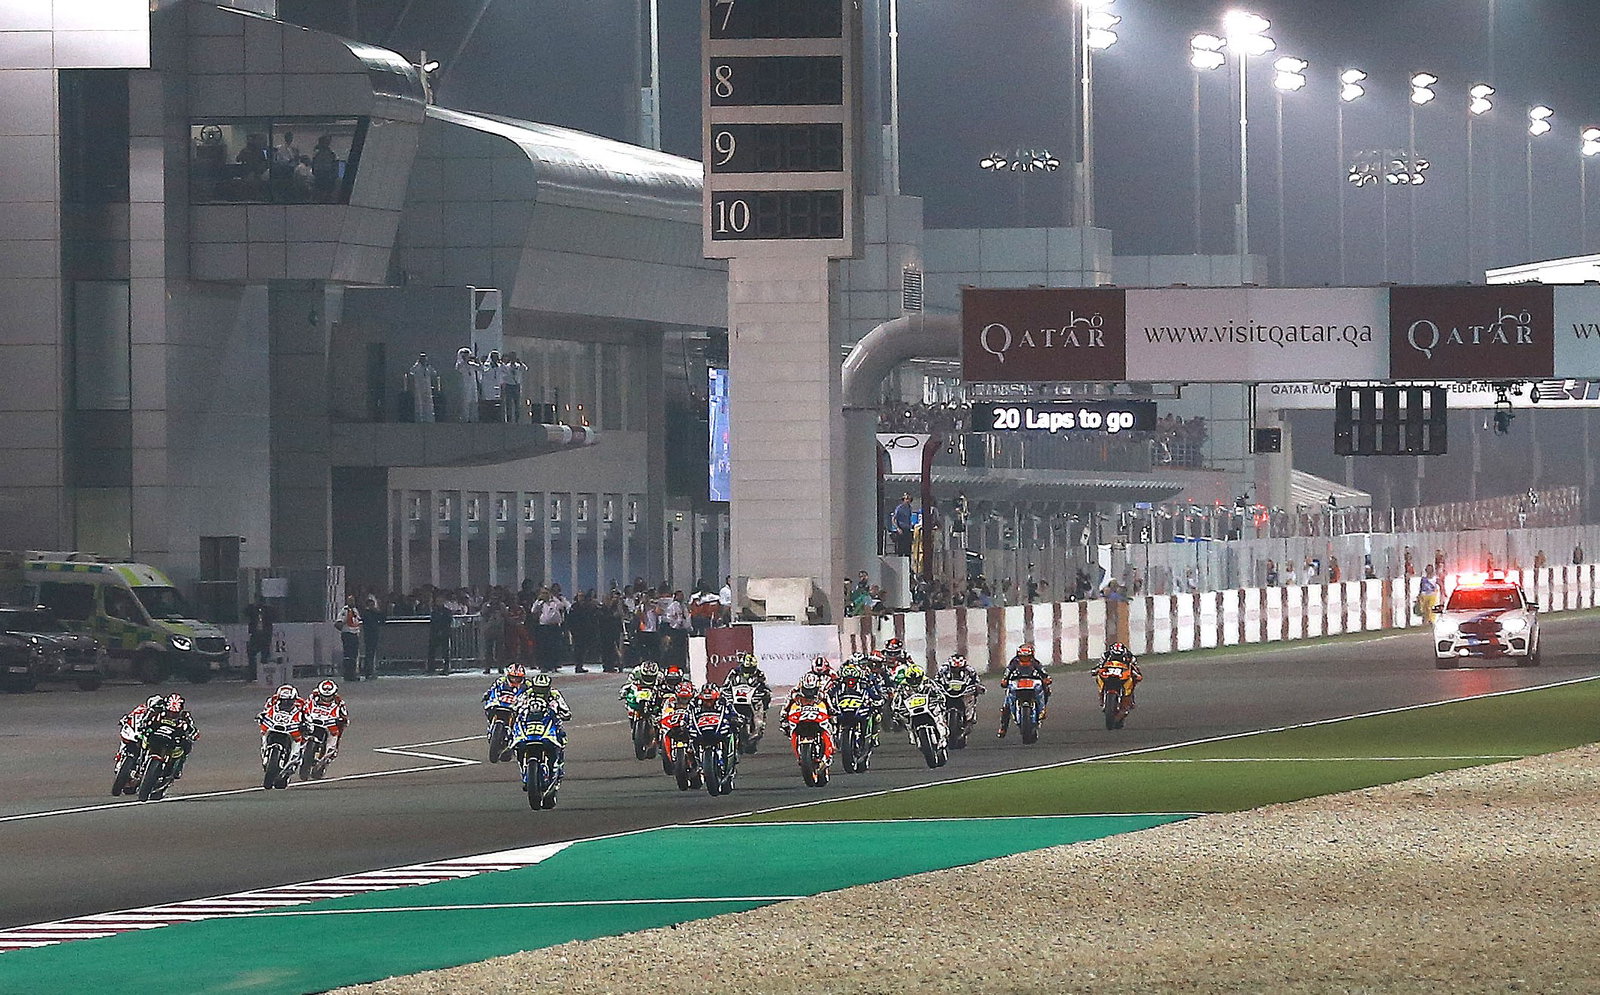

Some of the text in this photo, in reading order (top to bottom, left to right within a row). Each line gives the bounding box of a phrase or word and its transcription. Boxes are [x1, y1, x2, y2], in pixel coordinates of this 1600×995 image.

[715, 0, 735, 31] 7
[715, 65, 734, 98] 8
[715, 131, 736, 166] 9
[716, 200, 750, 233] 10
[980, 322, 1105, 364] QATAR
[1407, 319, 1533, 360] QATAR
[1271, 384, 1309, 395] QATAR
[993, 407, 1135, 434] 20 Laps to go
[710, 653, 746, 667] QATA
[799, 710, 819, 721] 26
[839, 698, 862, 708] 46
[526, 724, 546, 736] 29
